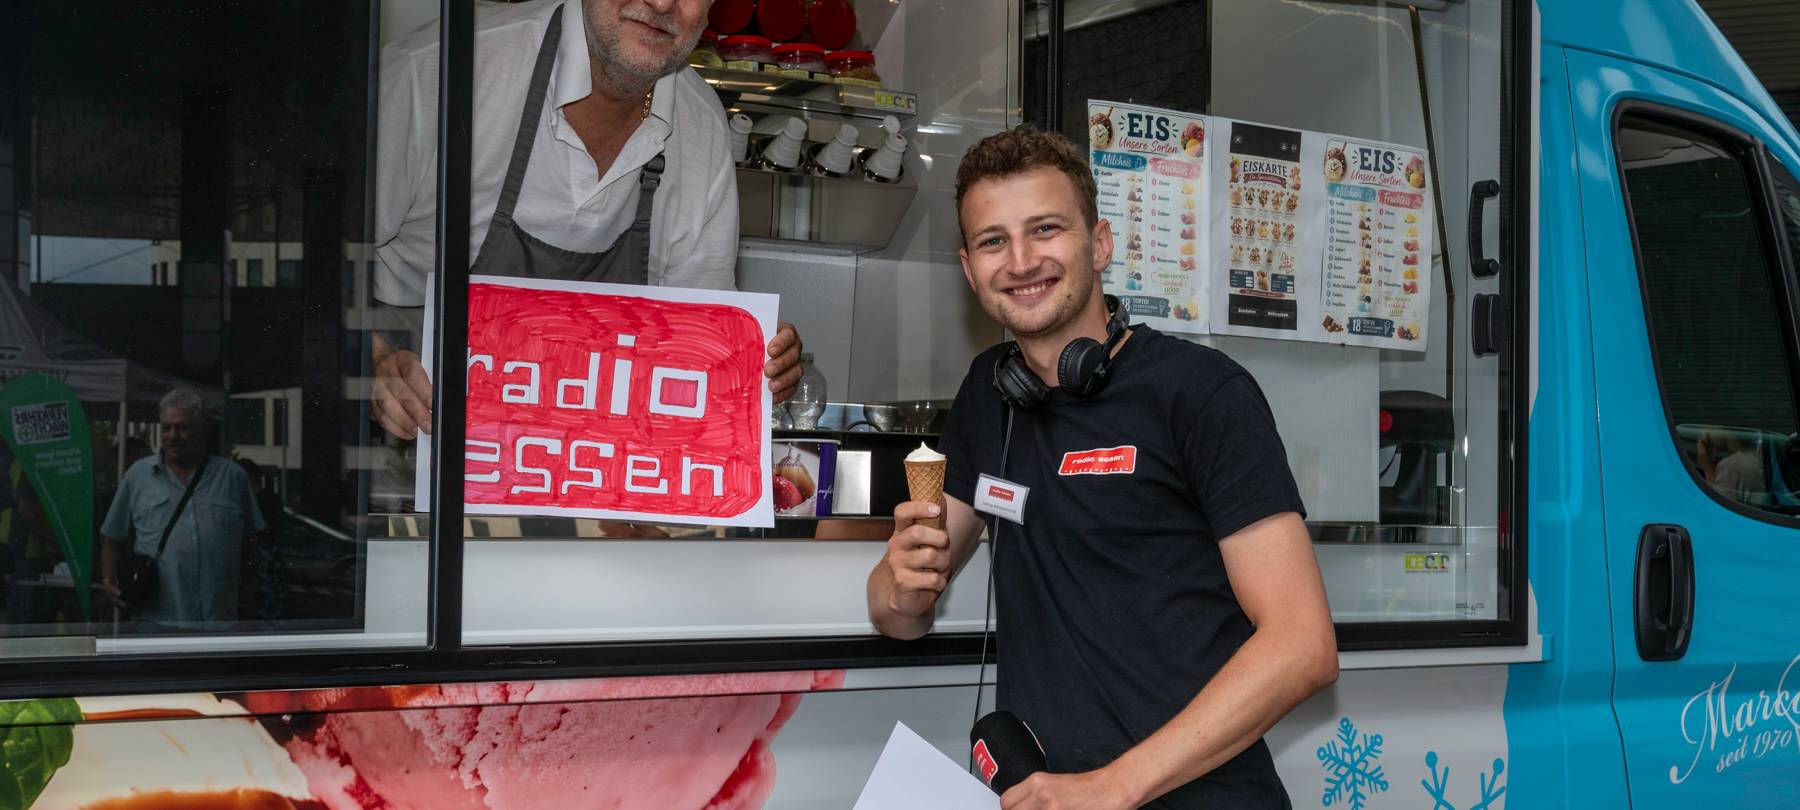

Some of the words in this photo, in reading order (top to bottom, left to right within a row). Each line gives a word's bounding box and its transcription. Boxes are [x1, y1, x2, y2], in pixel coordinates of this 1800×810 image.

[1127, 113, 1170, 141] EIS
[1118, 136, 1149, 150] Unsere
[1151, 139, 1179, 154] Sorten
[1243, 161, 1287, 178] EISKARTE
[1359, 148, 1395, 174] EIS
[1352, 319, 1361, 332] 18
[466, 334, 708, 418] radio
[464, 436, 724, 497] essen
[1072, 455, 1095, 464] radio
[1716, 735, 1749, 772] seit
[1752, 729, 1792, 758] 1970
